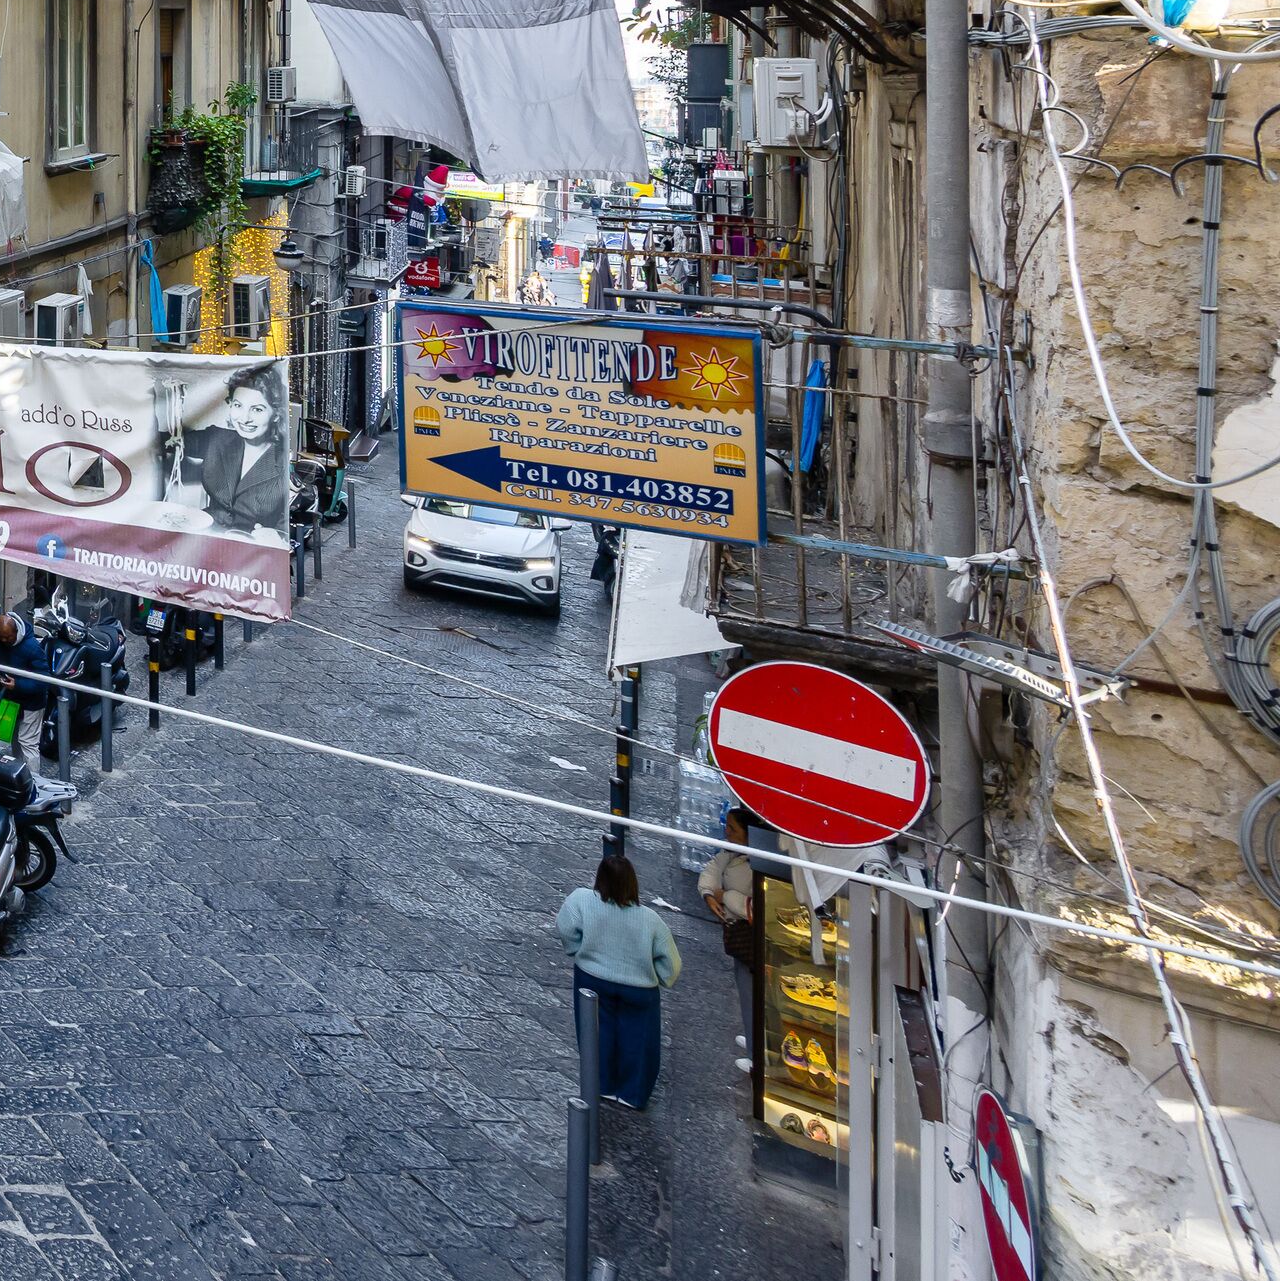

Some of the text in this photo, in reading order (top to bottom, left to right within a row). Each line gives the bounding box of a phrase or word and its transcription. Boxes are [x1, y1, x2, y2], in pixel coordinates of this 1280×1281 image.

[407, 274, 436, 282] vodafone
[461, 326, 678, 384] VIROFITENDE
[415, 385, 742, 437] Veneziane Tapparelle
[475, 376, 671, 410] Tende da Sole
[81, 408, 133, 434] Russ
[444, 405, 708, 451] Plissè Zanzariere
[489, 427, 658, 463] Riparazioni
[506, 460, 731, 510] Tel. 081.403852
[506, 483, 729, 528] Cell. 347.5630934
[73, 547, 277, 599] TRATTORIAOVESUVIONAPOLI
